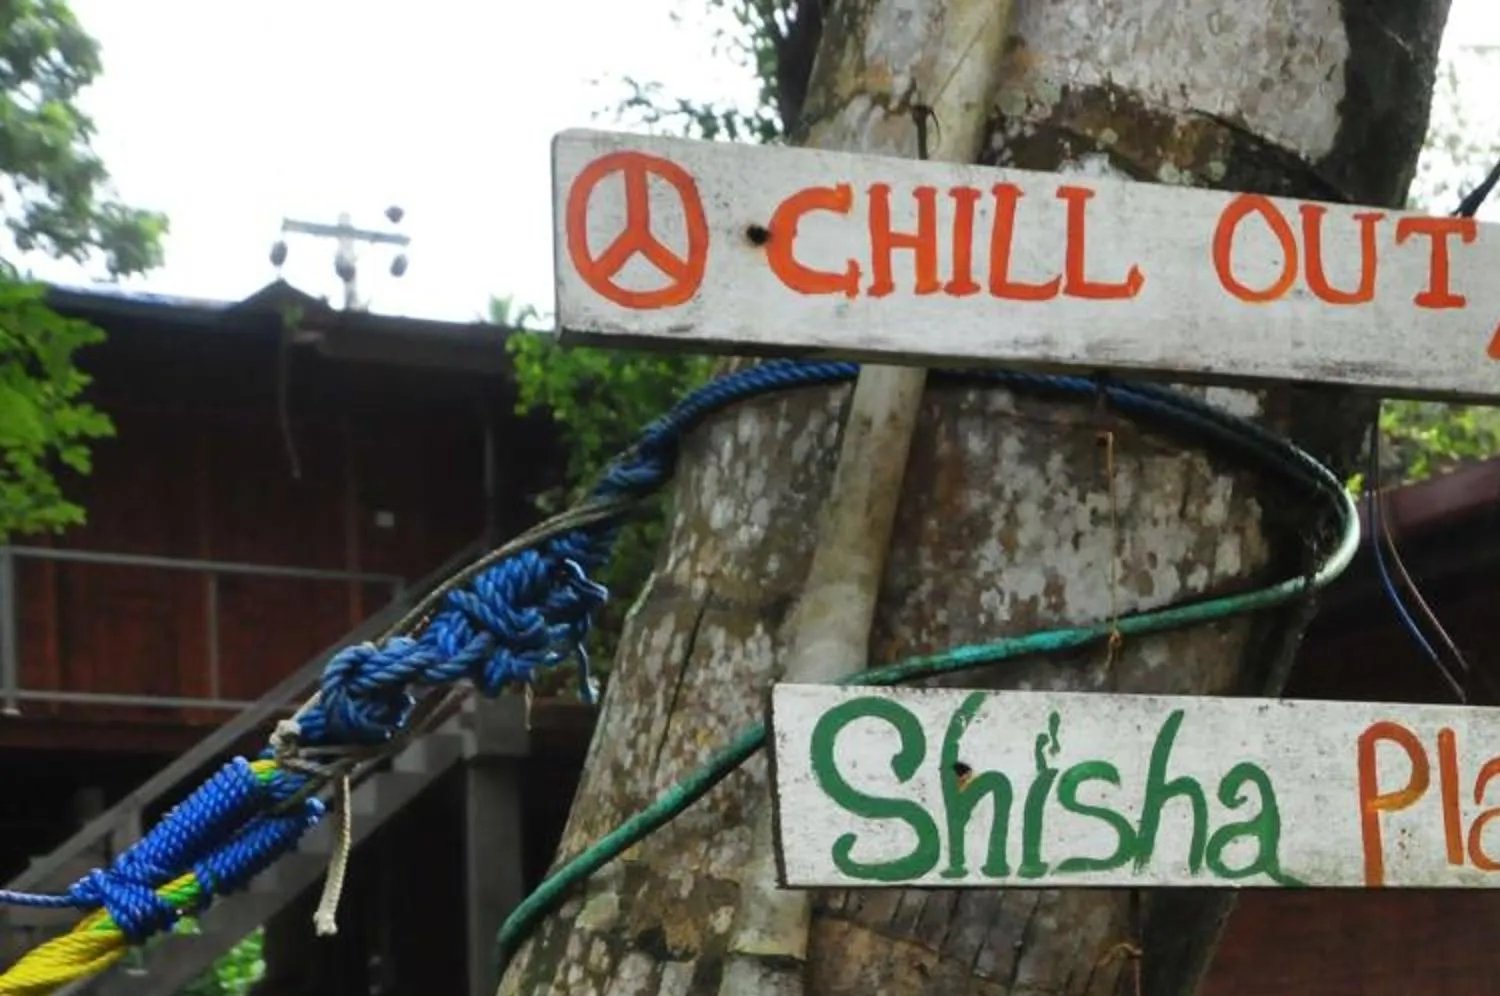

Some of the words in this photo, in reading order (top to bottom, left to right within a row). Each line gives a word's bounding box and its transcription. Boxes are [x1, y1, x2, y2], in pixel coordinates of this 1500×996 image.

[766, 181, 1146, 300] CHILL
[1212, 191, 1477, 309] OUT
[809, 691, 1309, 887] Shisha
